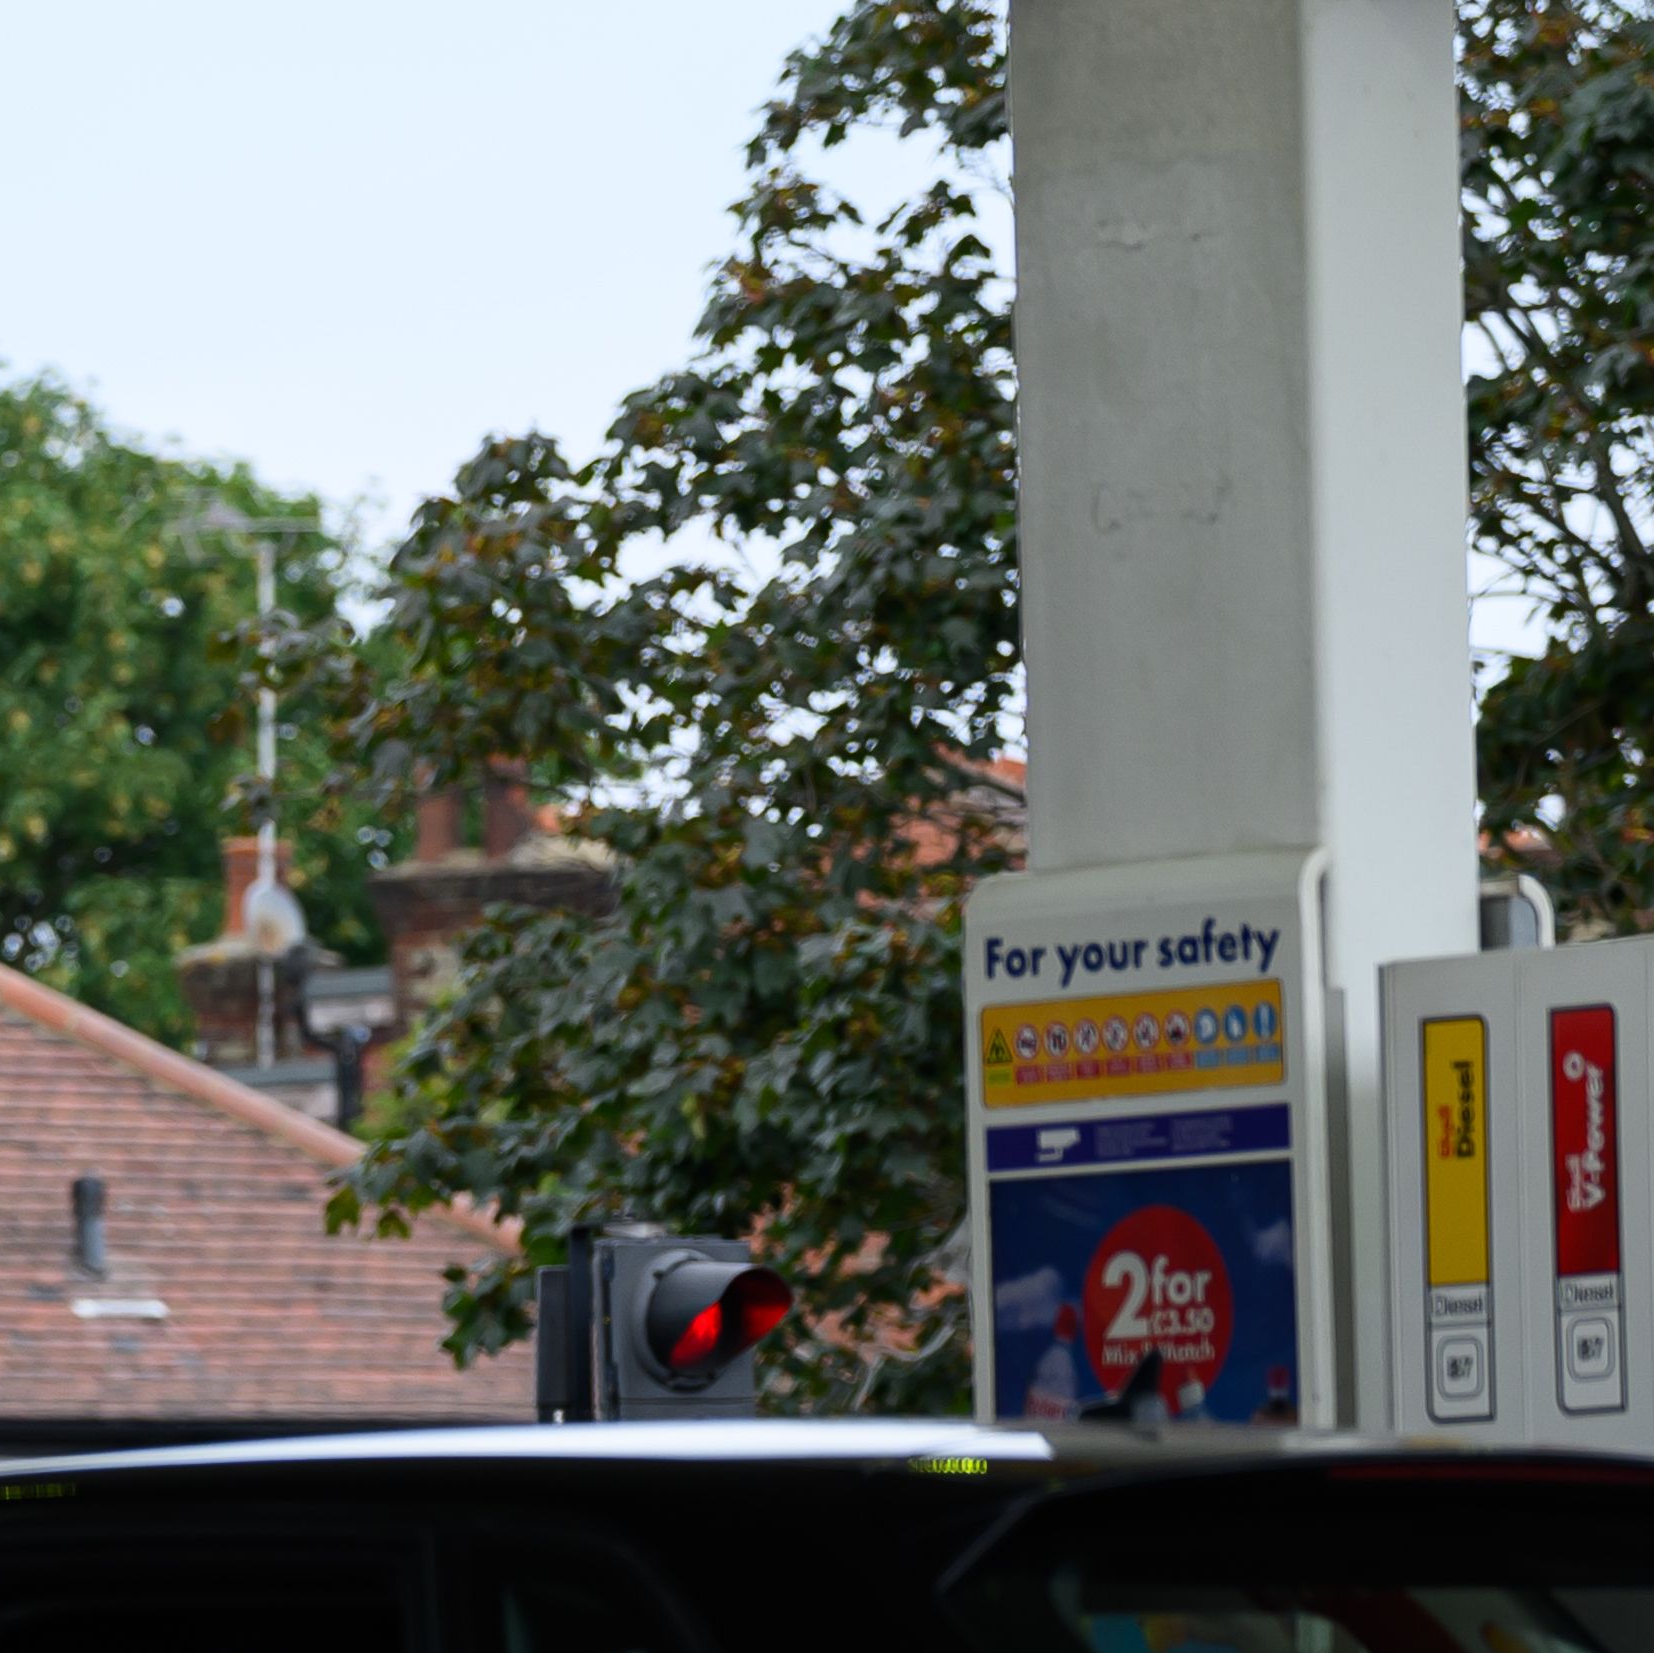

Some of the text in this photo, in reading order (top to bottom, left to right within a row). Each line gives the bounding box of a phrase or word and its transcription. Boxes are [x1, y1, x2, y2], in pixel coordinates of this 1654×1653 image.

[984, 916, 1280, 988] For your safety
[1452, 1060, 1475, 1158] Diesel
[1102, 1250, 1212, 1338] 2 for
